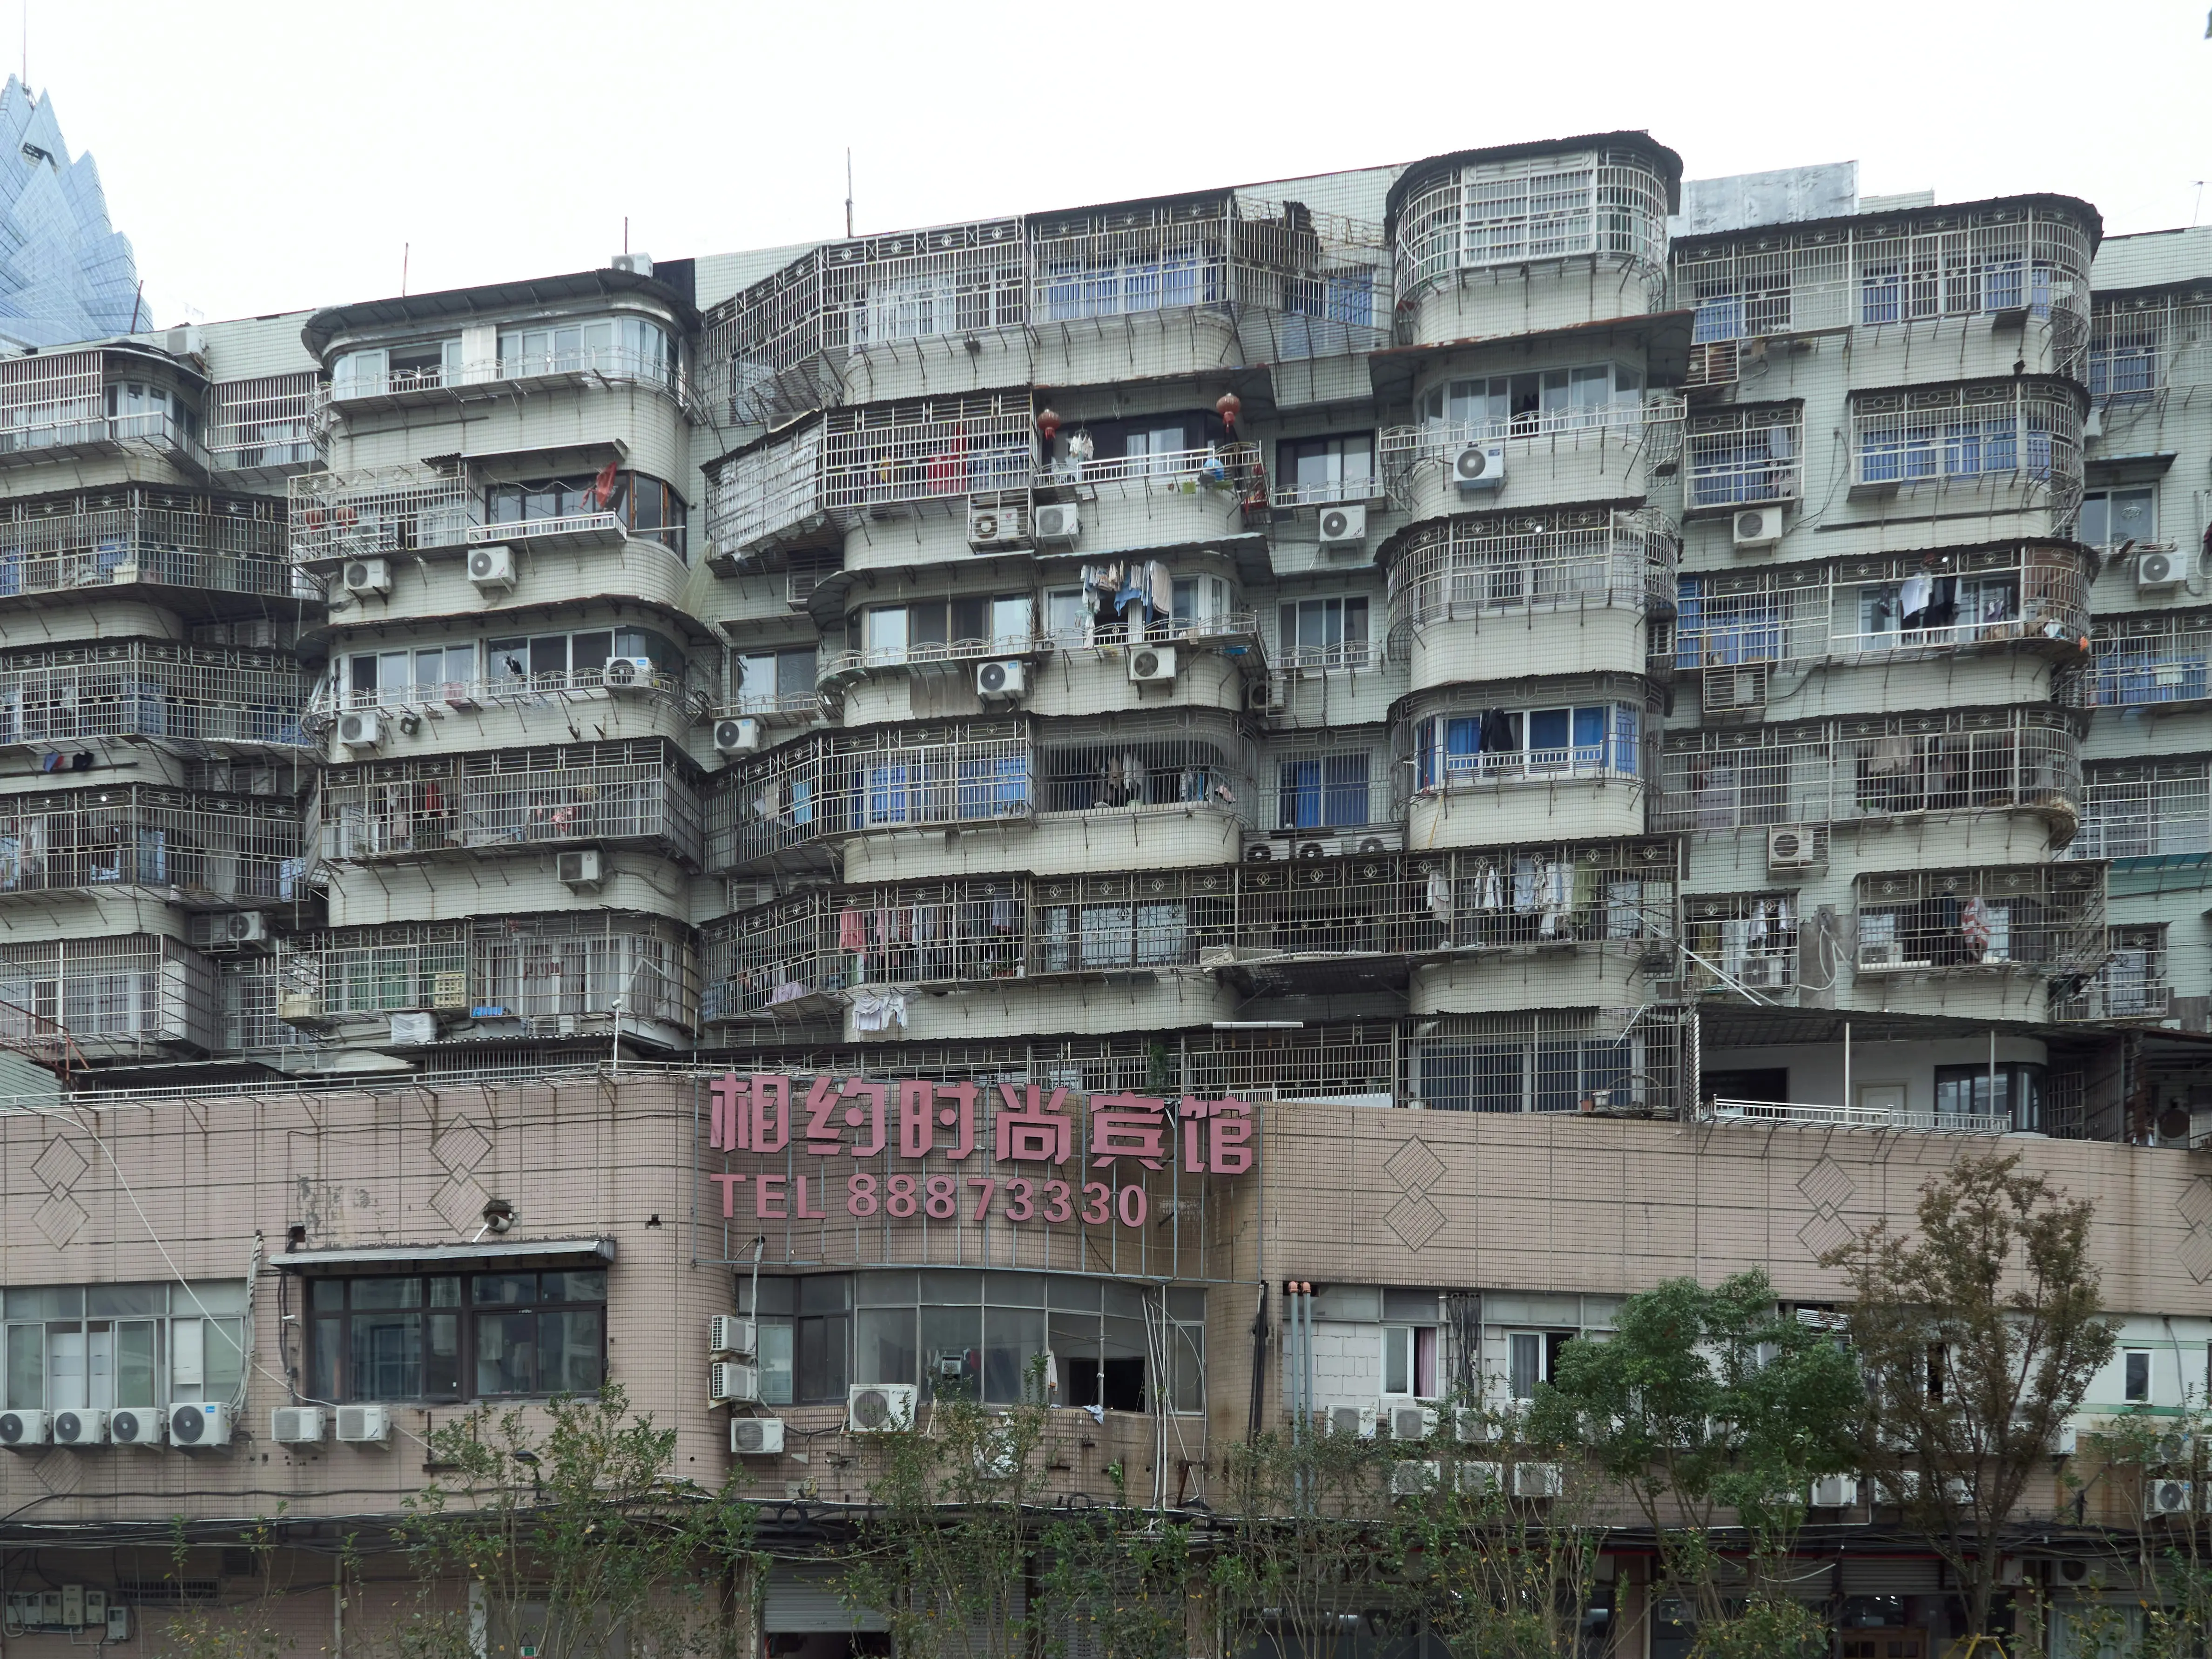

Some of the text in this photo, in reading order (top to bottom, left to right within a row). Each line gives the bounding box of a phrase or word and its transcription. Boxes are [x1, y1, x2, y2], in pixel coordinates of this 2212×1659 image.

[709, 1074, 1252, 1174] 相约时尚宾馆
[710, 1173, 1147, 1227] TEL 88873330
